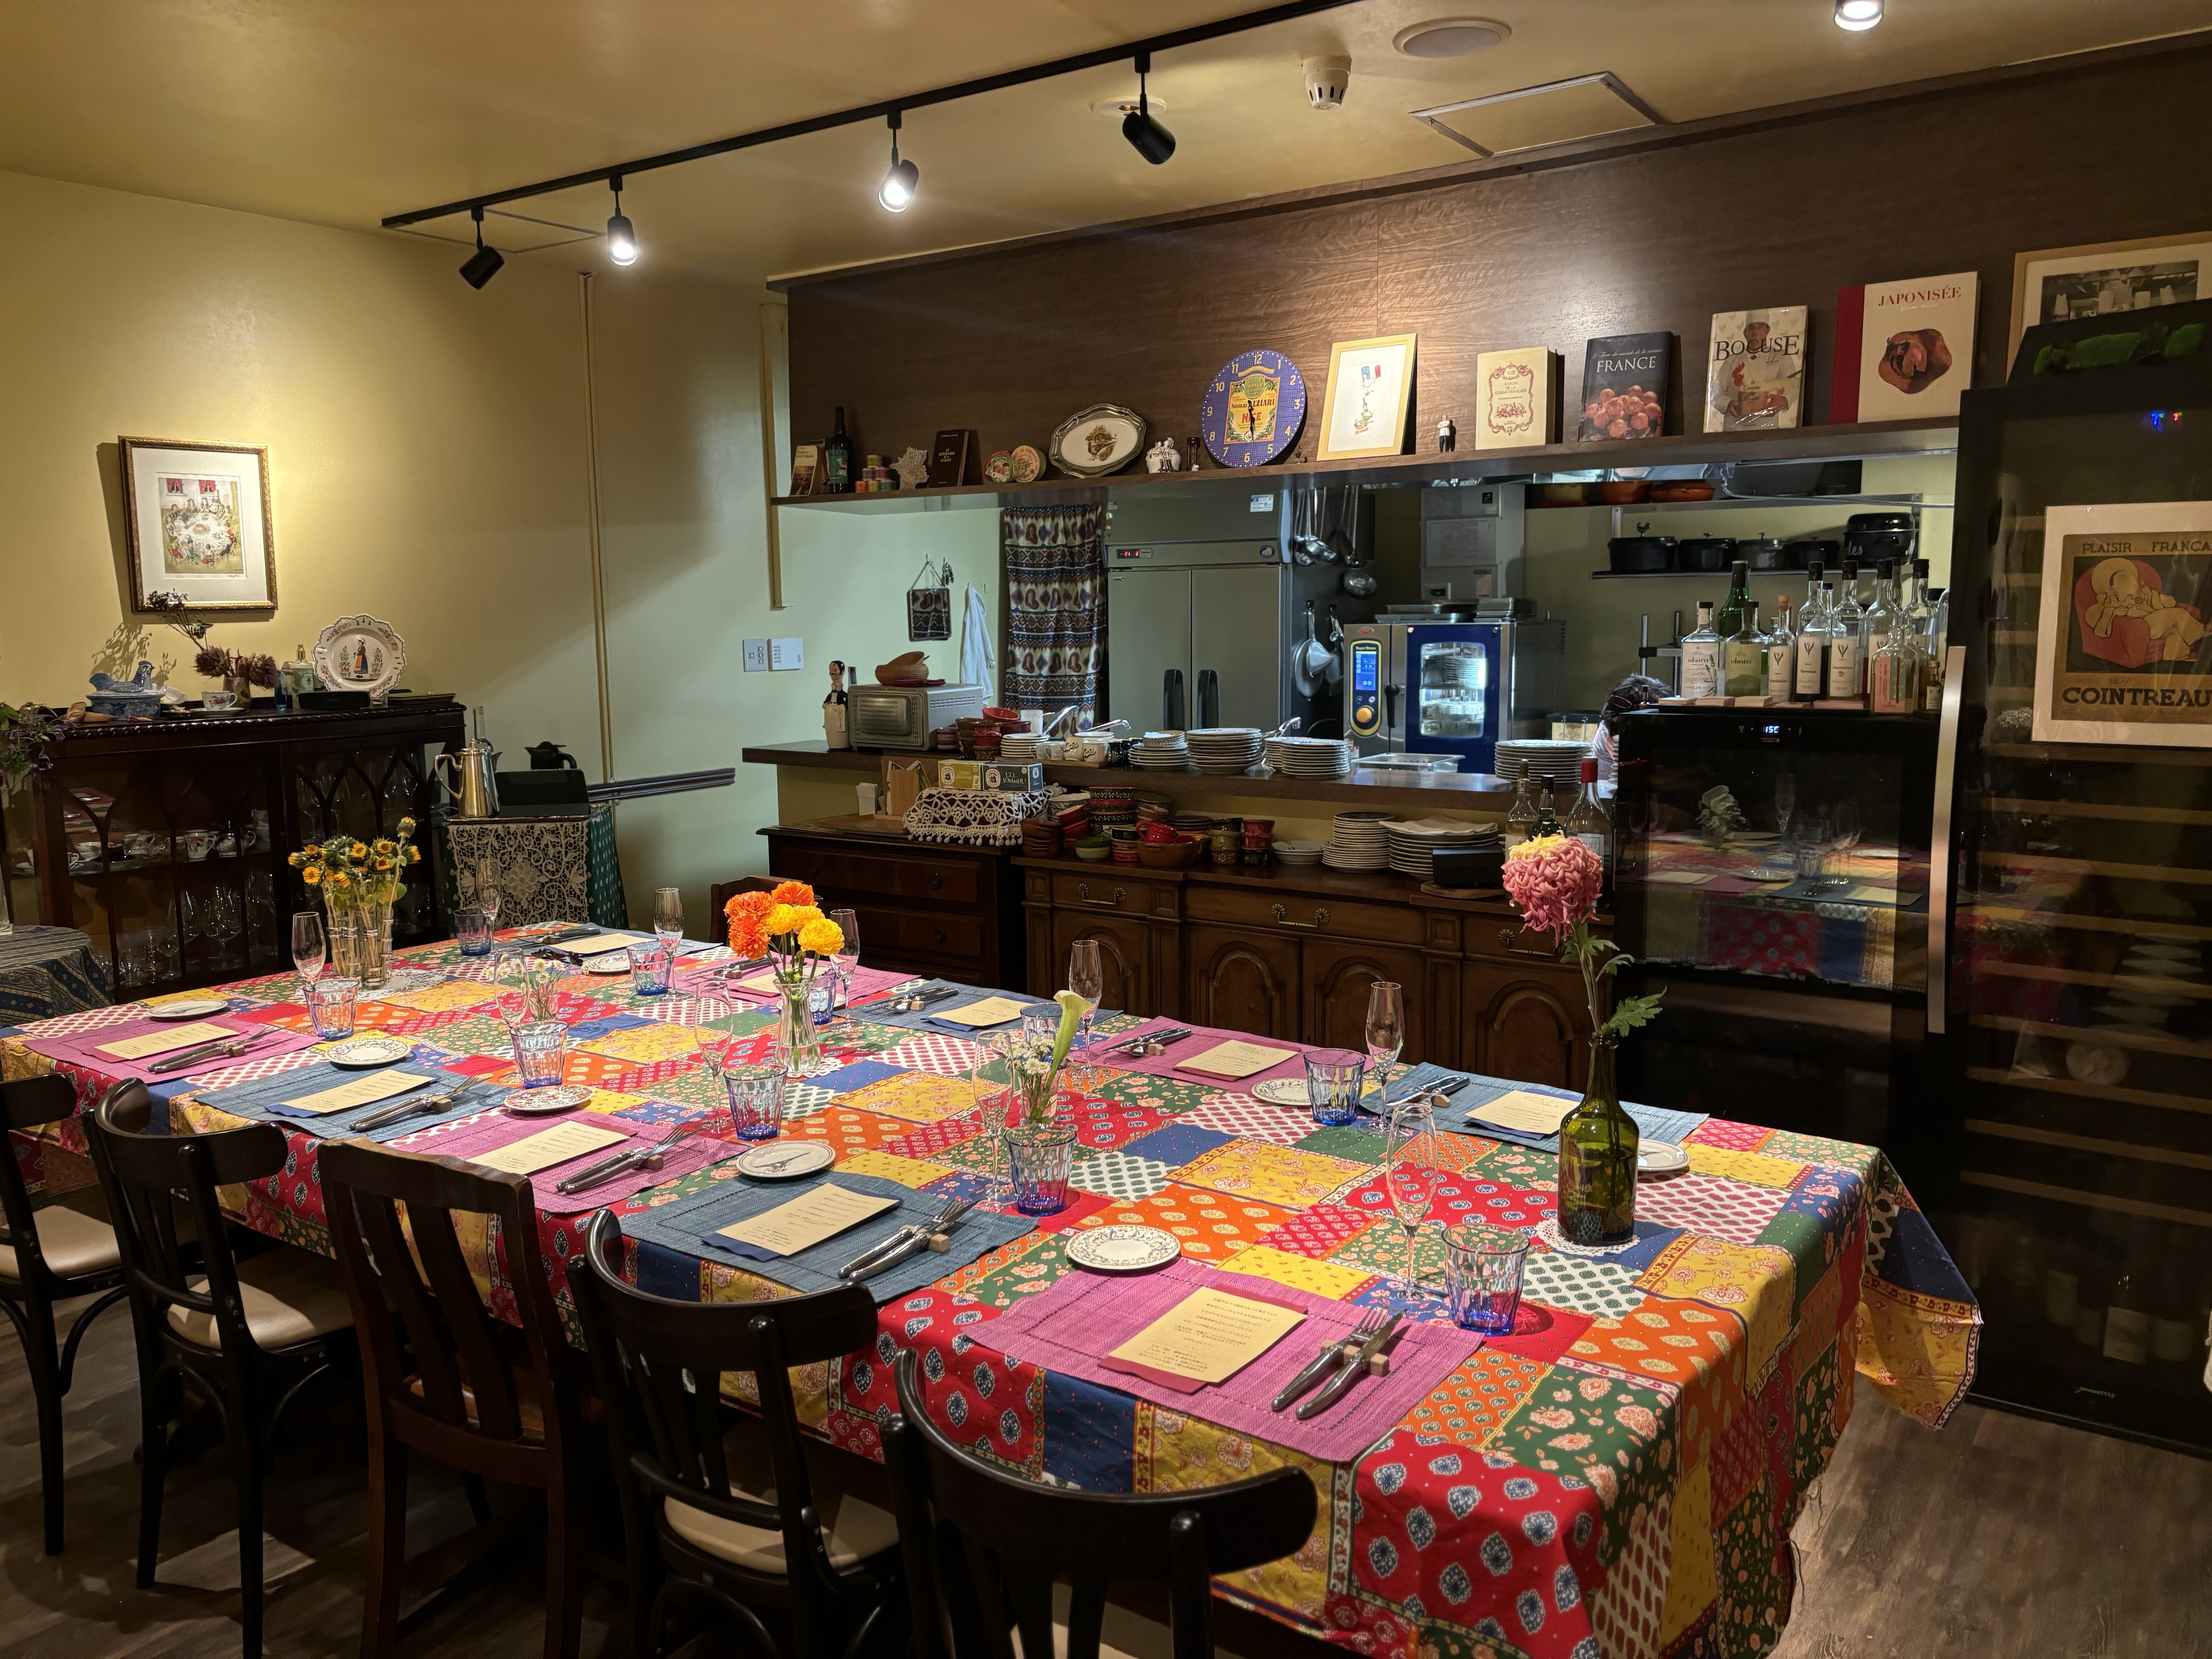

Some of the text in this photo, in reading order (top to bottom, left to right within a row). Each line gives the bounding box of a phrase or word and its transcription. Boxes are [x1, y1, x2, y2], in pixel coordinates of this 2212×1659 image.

[1878, 285, 1961, 306] JAPONISÉE
[1714, 335, 1799, 361] BOCUSE
[1254, 354, 1262, 364] 12
[1278, 359, 1281, 369] 1
[1597, 356, 1656, 372] FRANCE
[1231, 362, 1238, 374] 11
[1290, 375, 1296, 385] 2
[1216, 381, 1224, 392] 10
[1251, 398, 1274, 407] LZIARI
[1294, 398, 1300, 409] 3
[1207, 407, 1212, 416] 9
[1285, 426, 1290, 435] 4
[1209, 431, 1215, 441] 8
[1223, 447, 1228, 457] 7
[1267, 443, 1273, 453] 5
[1244, 453, 1250, 462] 6
[2082, 542, 2131, 553] PLAISIR
[2062, 687, 2212, 708] COINTREAU
